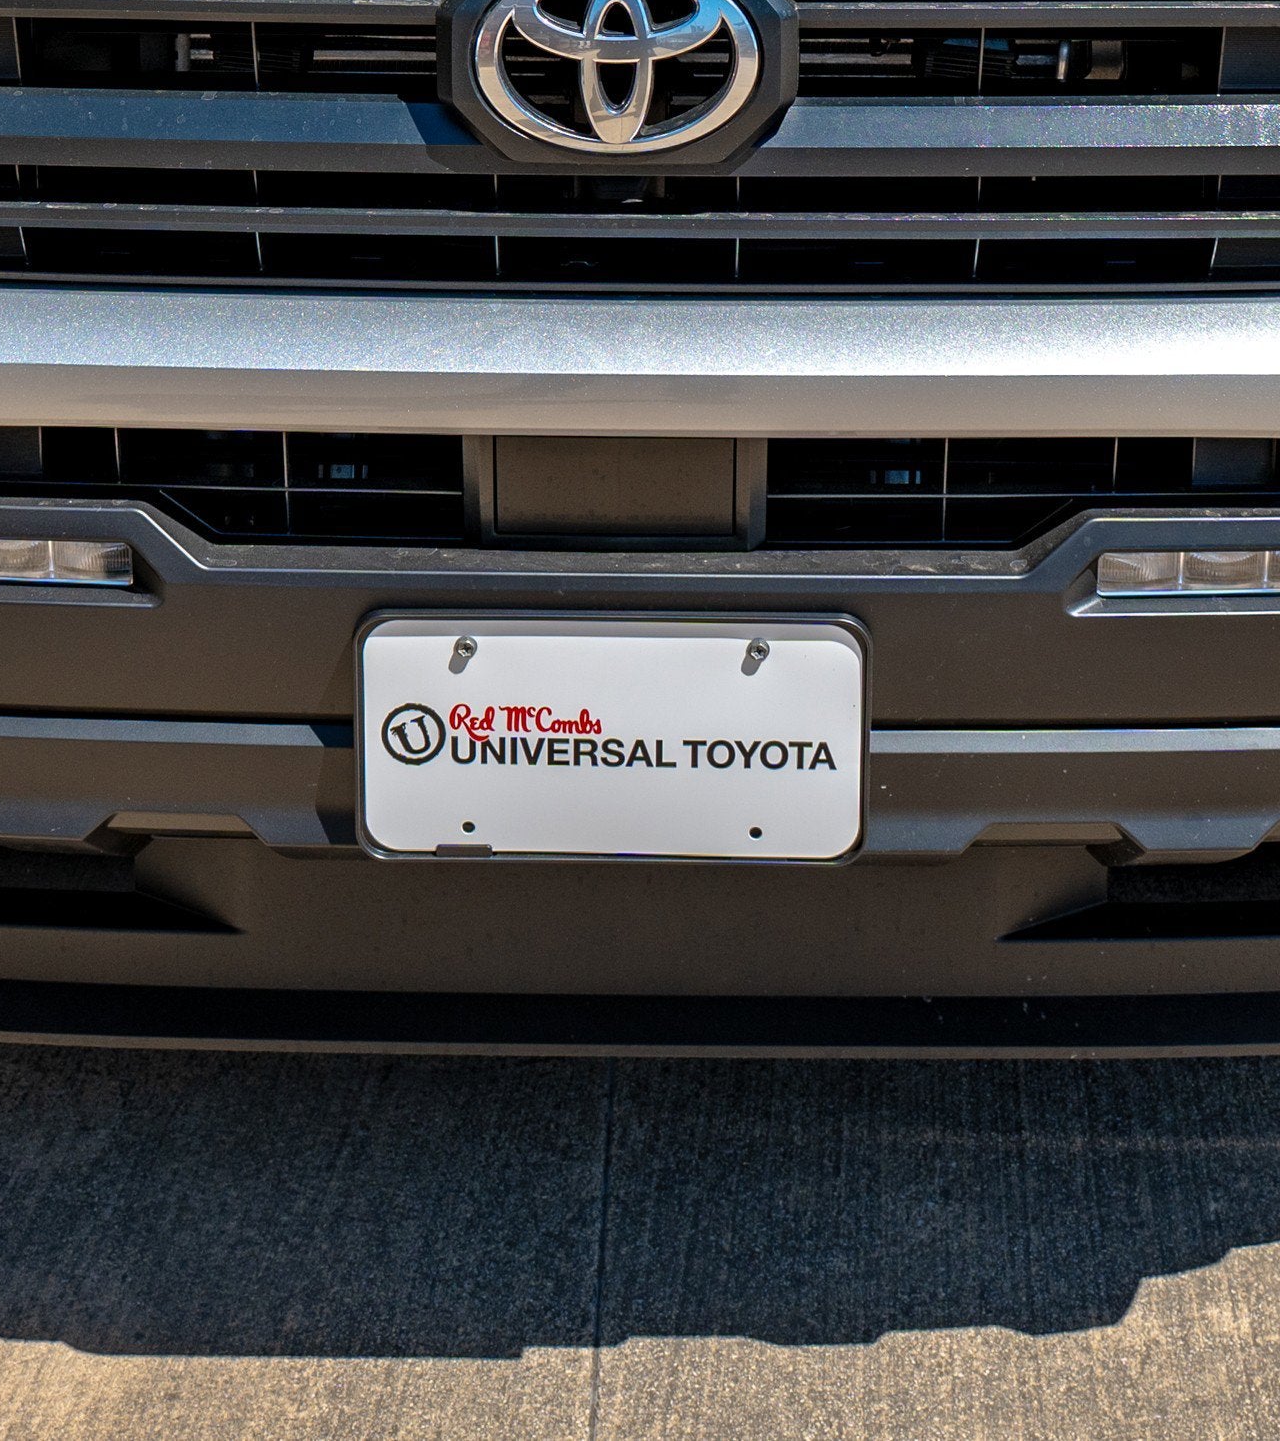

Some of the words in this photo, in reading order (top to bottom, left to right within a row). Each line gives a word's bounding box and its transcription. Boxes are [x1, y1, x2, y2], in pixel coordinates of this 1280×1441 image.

[449, 703, 495, 742] Red
[500, 705, 602, 735] McCombs
[450, 736, 677, 768] UNIVERSAL
[683, 739, 837, 770] TOYOTA
